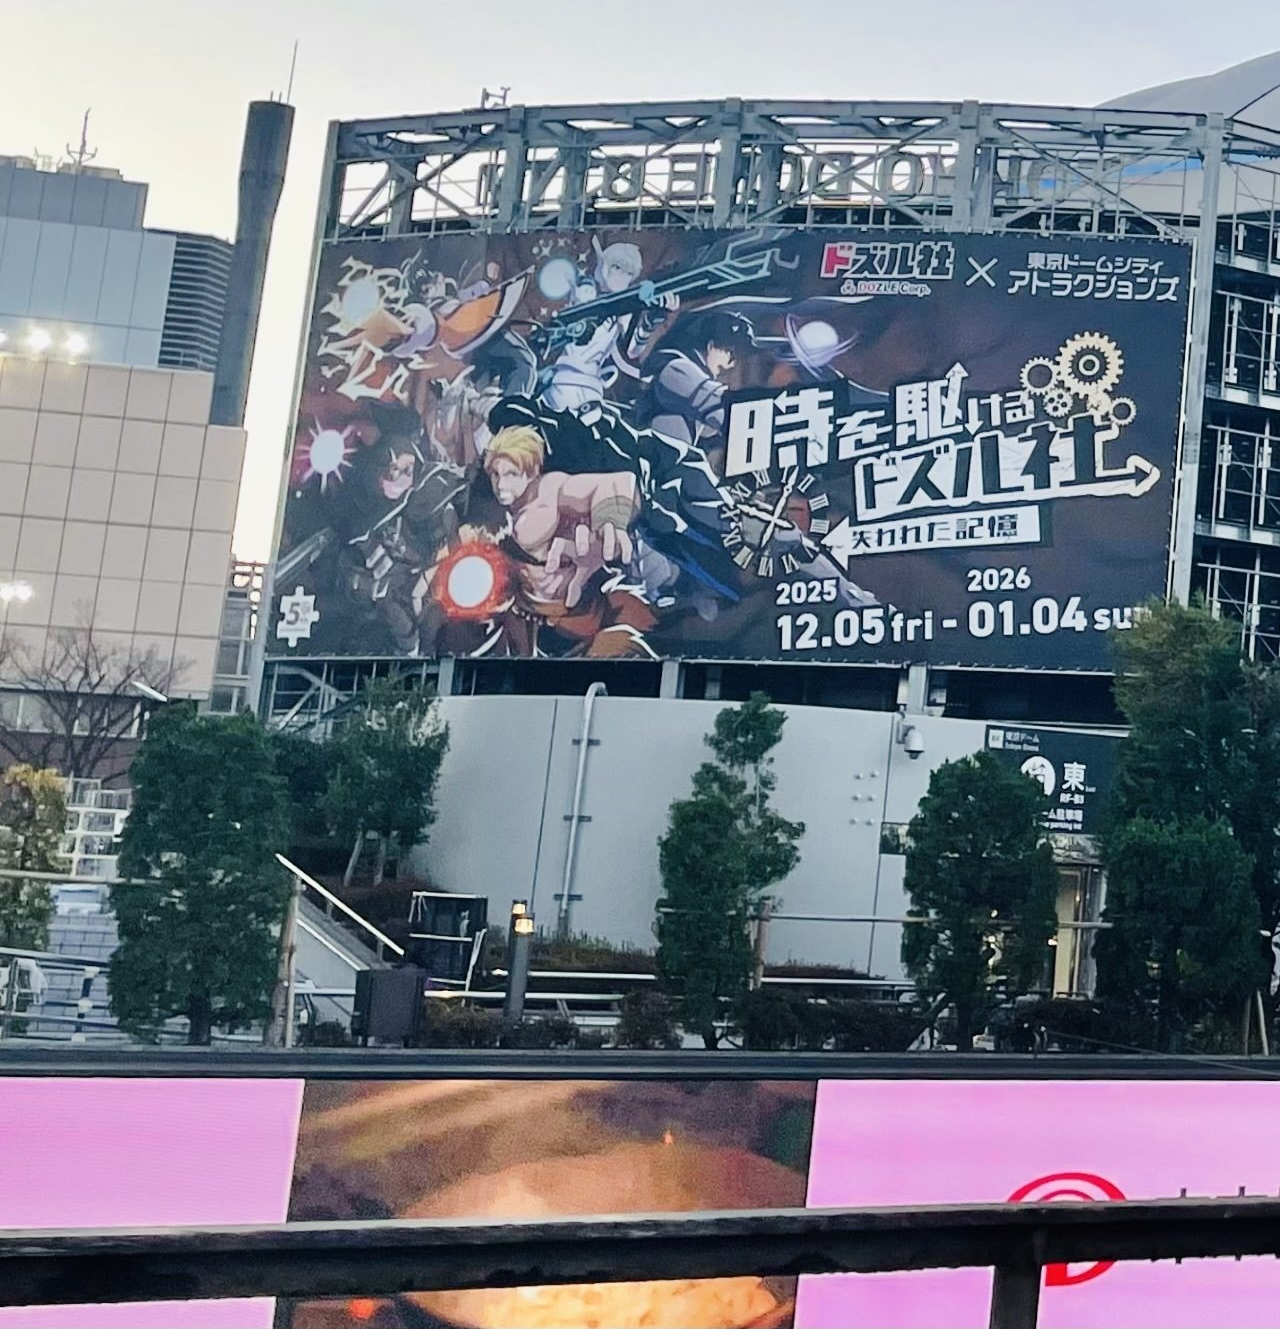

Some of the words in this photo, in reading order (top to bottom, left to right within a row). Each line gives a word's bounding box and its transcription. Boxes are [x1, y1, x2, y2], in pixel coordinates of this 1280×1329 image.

[820, 241, 955, 279] ドズル社
[1027, 252, 1164, 276] 東京ドームシティ
[1007, 270, 1180, 301] アトラクションズ
[776, 579, 837, 605] 2025
[967, 568, 1031, 592] 2026
[1062, 762, 1086, 790] 東
